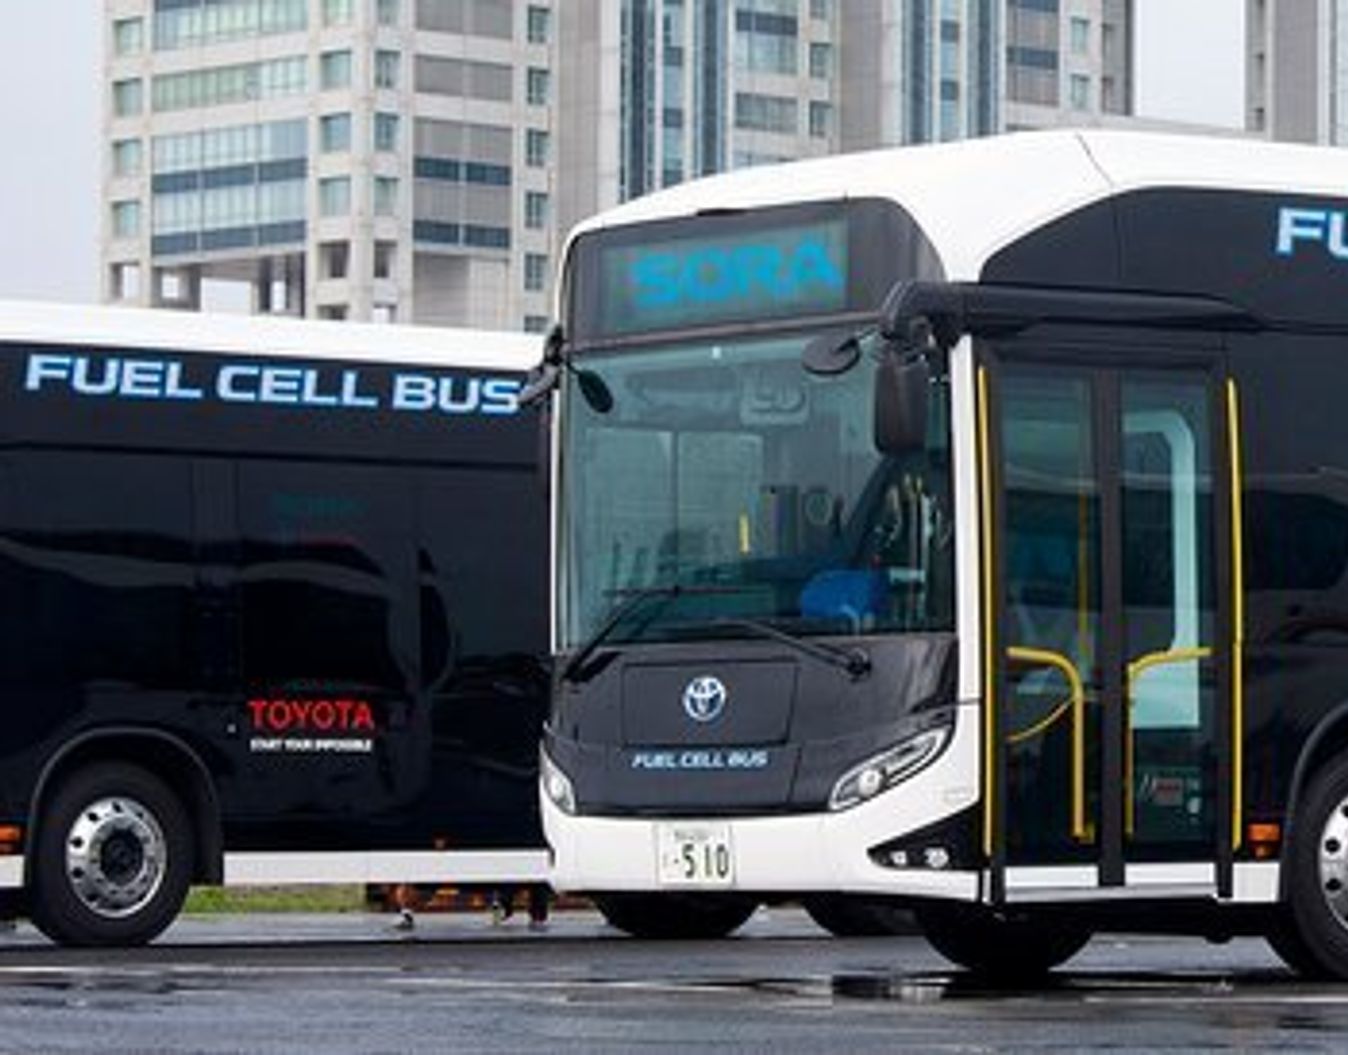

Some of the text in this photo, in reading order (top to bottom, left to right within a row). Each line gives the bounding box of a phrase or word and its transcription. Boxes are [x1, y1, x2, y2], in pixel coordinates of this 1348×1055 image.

[632, 233, 844, 309] SORA
[24, 353, 521, 415] FUEL CELL BUS
[248, 700, 375, 731] TOYOTA
[631, 750, 768, 769] FUEL CELL BUS
